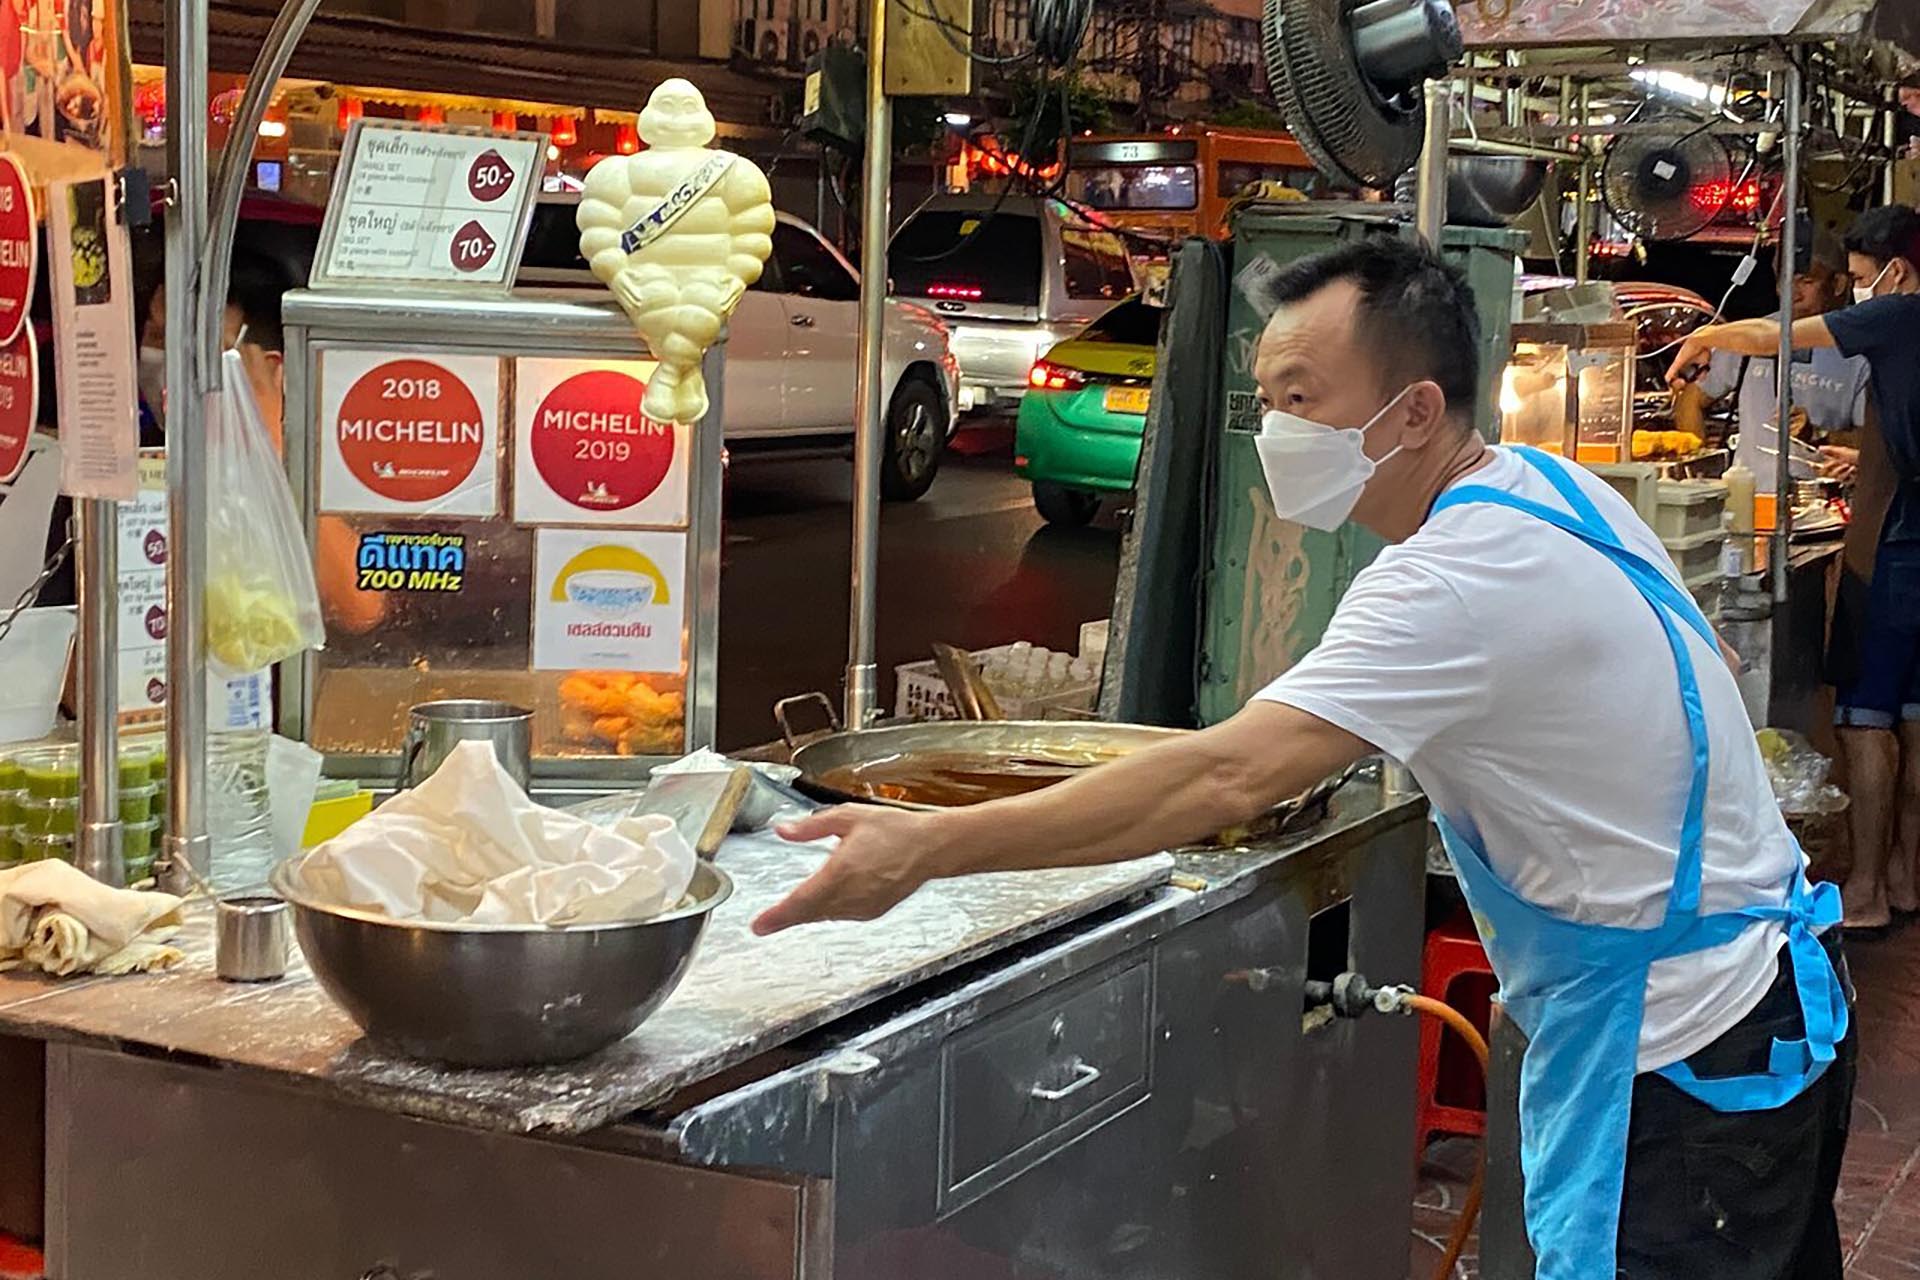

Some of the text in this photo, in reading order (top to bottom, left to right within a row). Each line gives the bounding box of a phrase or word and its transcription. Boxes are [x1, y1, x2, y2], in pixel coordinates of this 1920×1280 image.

[1121, 145, 1139, 158] 73
[474, 165, 513, 189] 50.-
[348, 209, 399, 235] ชุดใหญ่
[0, 239, 29, 268] ELIN
[459, 237, 495, 261] 70.-
[381, 377, 441, 400] 2018
[340, 418, 481, 444] MICHELIN
[574, 438, 630, 461] 2019
[360, 535, 463, 570] ดีแทค
[360, 570, 462, 590] 700 MHz
